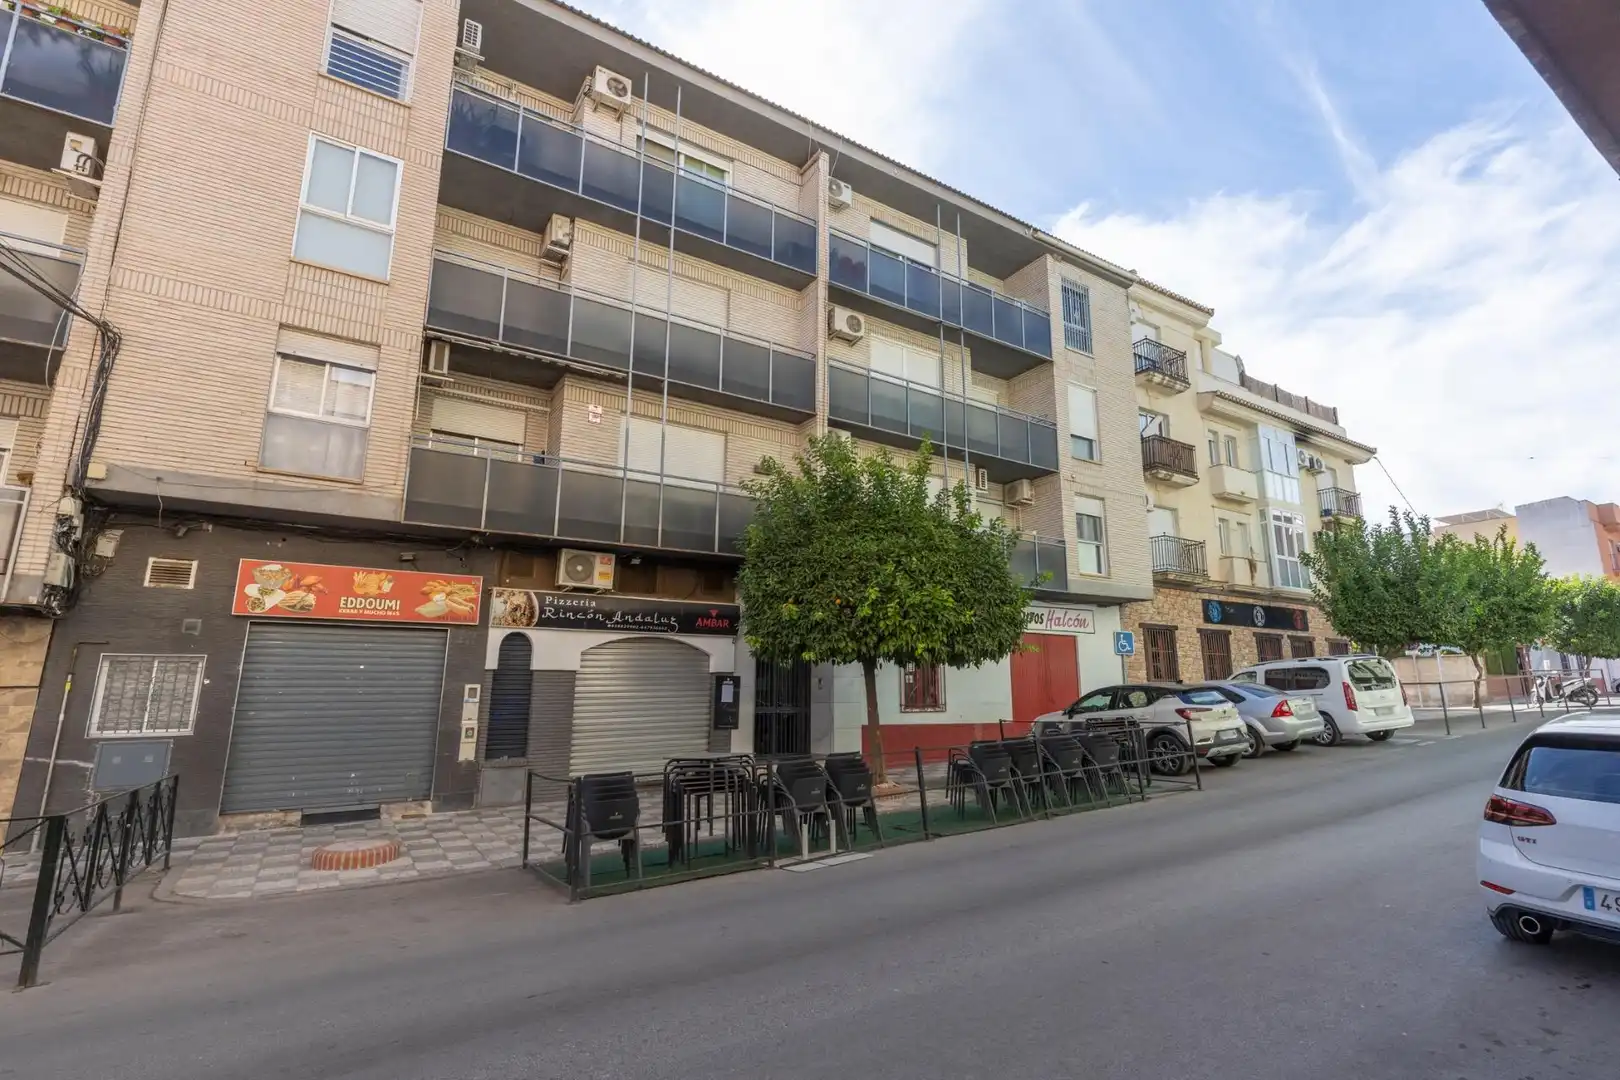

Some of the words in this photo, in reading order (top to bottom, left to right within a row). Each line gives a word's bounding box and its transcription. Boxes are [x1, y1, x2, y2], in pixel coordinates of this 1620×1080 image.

[339, 596, 401, 611] EDDOUMI
[545, 595, 597, 607] Pizzeria
[541, 606, 606, 621] Rincón
[606, 610, 679, 633] Andaluz
[695, 617, 730, 629] AMBAR
[1045, 609, 1089, 629] Halcón
[1517, 835, 1537, 844] GTI
